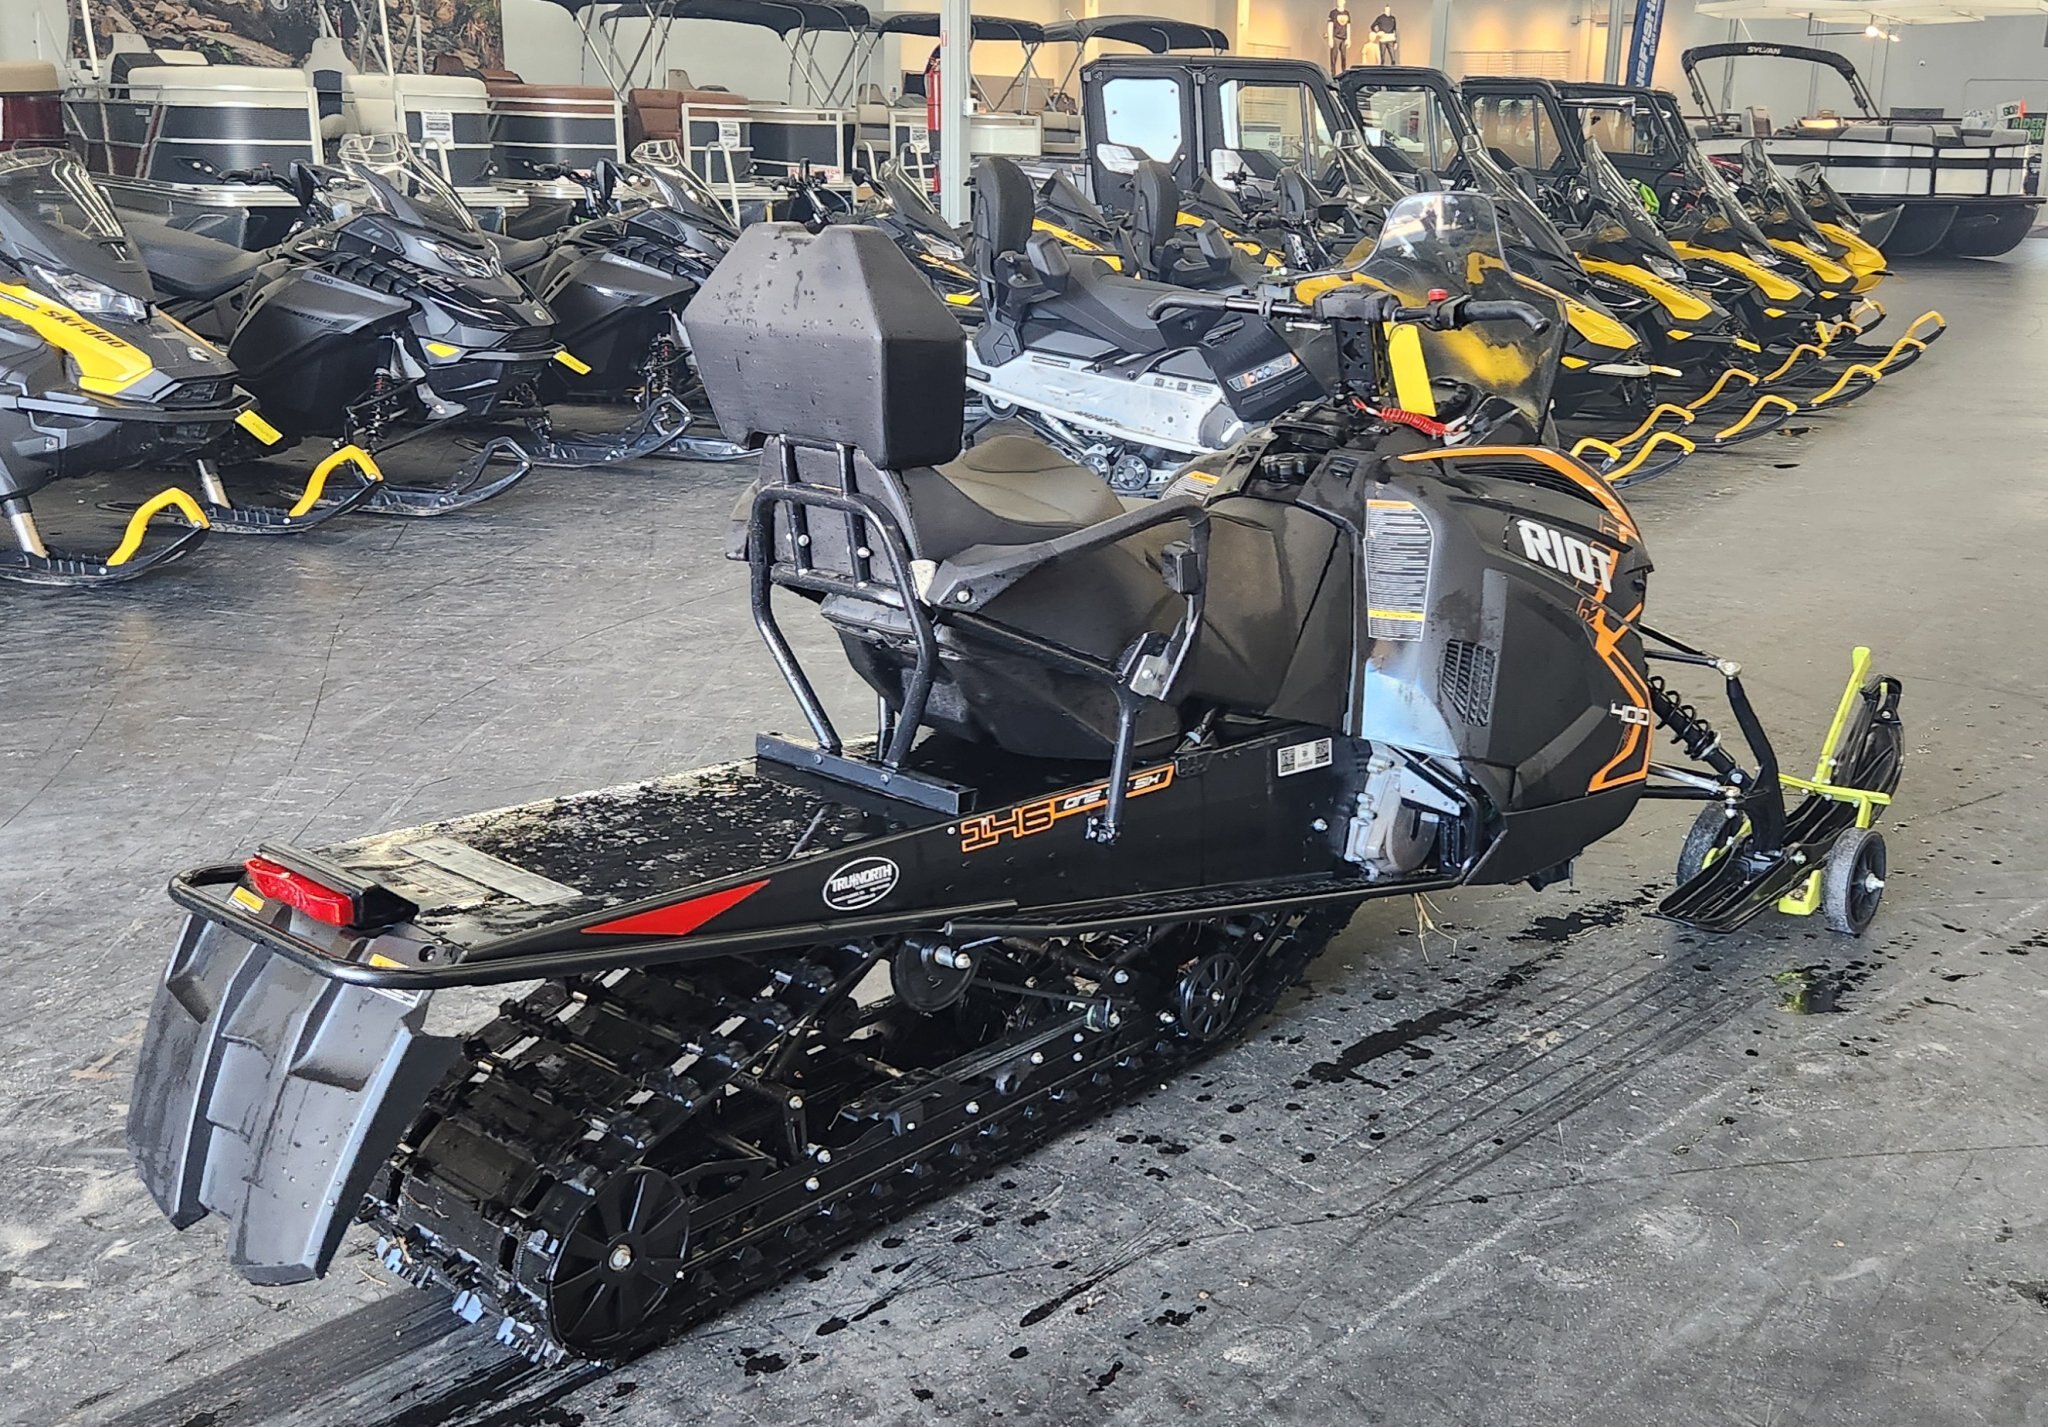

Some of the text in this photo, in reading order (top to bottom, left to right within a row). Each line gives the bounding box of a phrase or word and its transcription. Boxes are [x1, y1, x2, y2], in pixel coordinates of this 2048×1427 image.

[1636, 0, 1658, 88] NGFISH
[1747, 45, 1781, 55] SYLVAN
[1516, 519, 1613, 594] RIOT
[1610, 702, 1650, 726] 400
[960, 799, 1054, 853] 146
[1063, 789, 1102, 810] ONE
[1133, 773, 1161, 790] SIX
